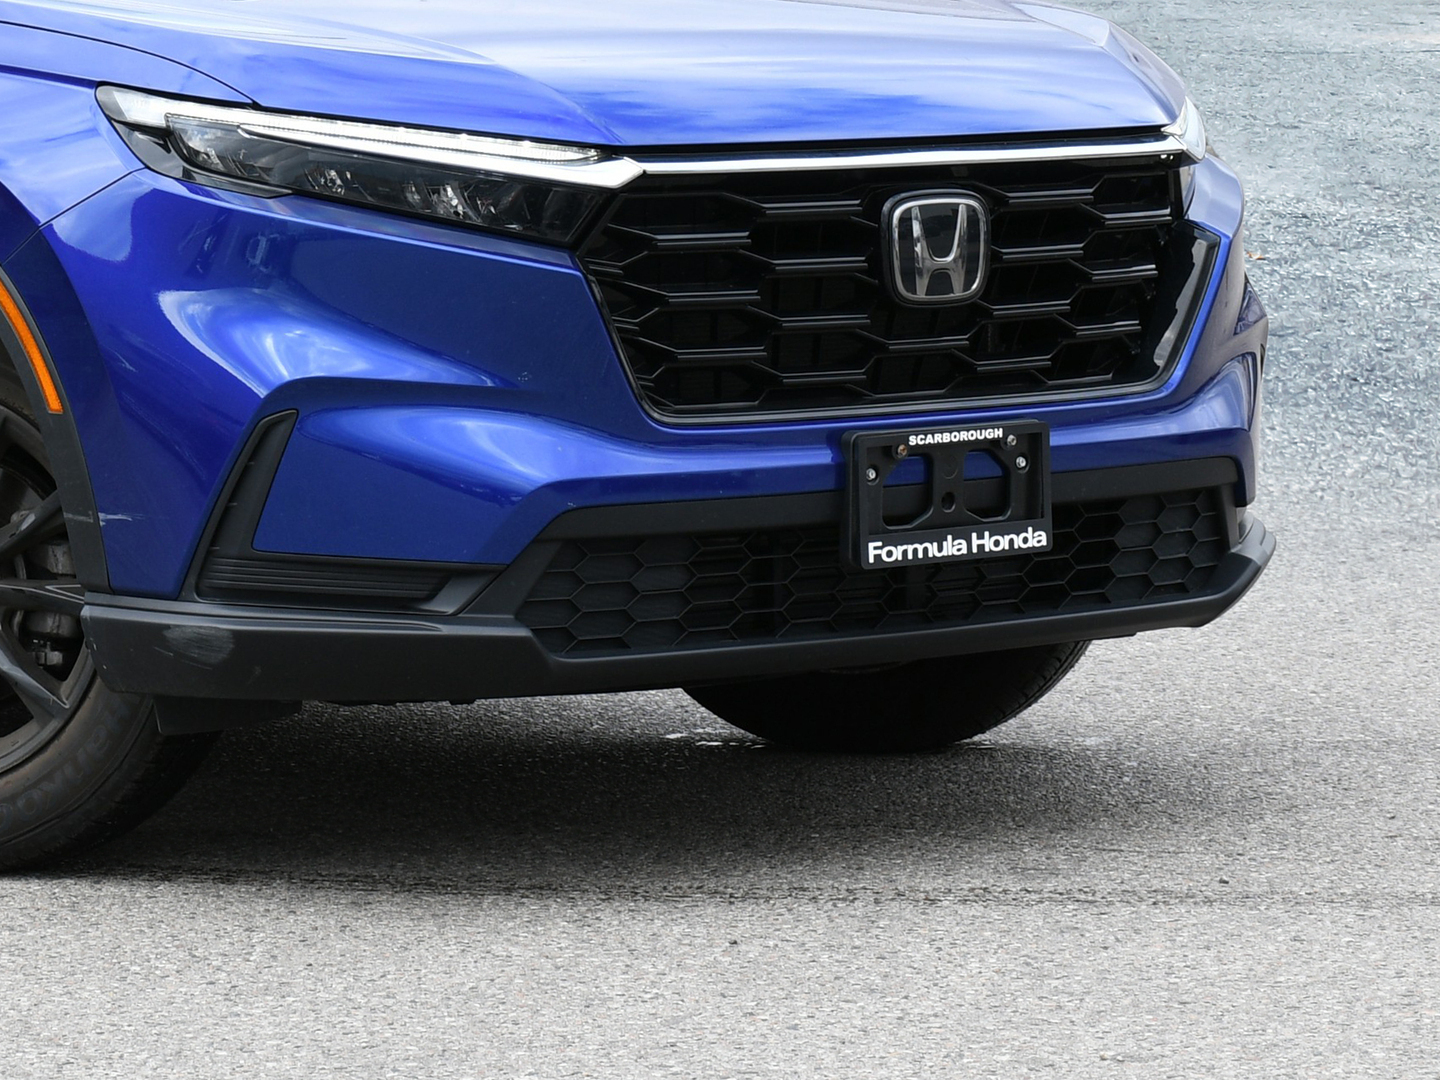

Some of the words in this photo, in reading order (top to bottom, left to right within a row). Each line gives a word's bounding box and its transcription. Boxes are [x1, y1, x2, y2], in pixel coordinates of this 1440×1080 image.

[908, 428, 1003, 446] SCARBOROUGH
[867, 534, 968, 564] Formula
[971, 526, 1048, 554] Honda
